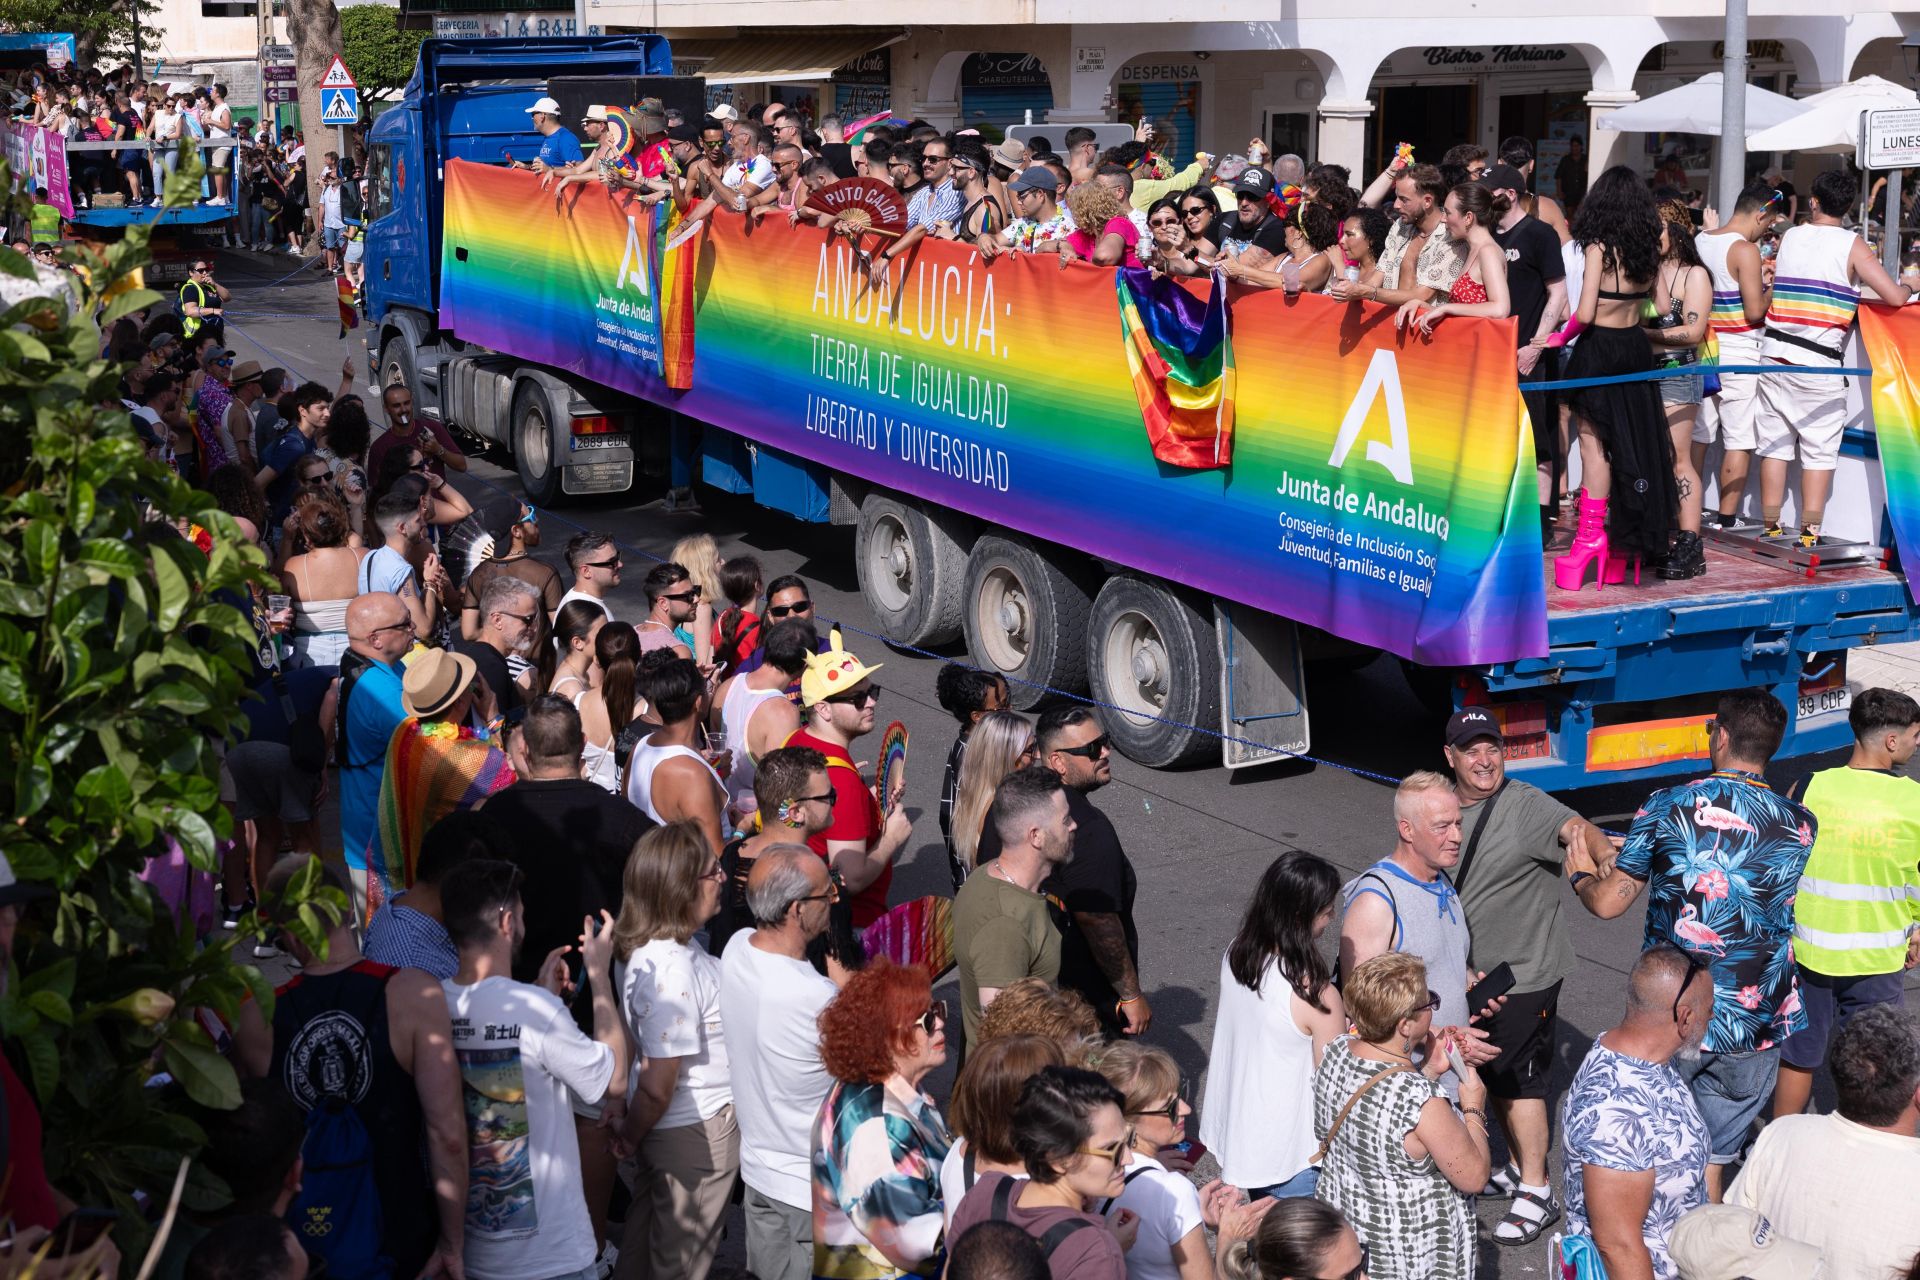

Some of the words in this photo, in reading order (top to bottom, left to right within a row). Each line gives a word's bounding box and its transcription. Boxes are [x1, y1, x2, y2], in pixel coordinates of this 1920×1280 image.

[537, 18, 600, 37] BAHA
[1423, 47, 1484, 65] Bistro
[1492, 45, 1567, 63] Adriano
[1122, 65, 1200, 80] DESPENSA
[1883, 135, 1920, 149] LUNES
[825, 186, 863, 206] PUTO
[864, 188, 900, 224] CALOR
[596, 293, 617, 313] Junta
[619, 298, 630, 316] de
[631, 301, 653, 323] Andal
[813, 242, 1011, 360] ANDALUCÍA:
[627, 328, 650, 343] Inclusión
[811, 333, 869, 391] TIERRA
[878, 351, 902, 399] DE
[911, 361, 1009, 429] IGUALDAD
[577, 437, 603, 448] 2089
[608, 435, 628, 447] CDP
[806, 393, 877, 450] LIBERTAD
[884, 417, 894, 456] Y
[901, 422, 1009, 492] DIVERSIDAD
[1276, 470, 1330, 507] Junta
[1333, 483, 1359, 514] de
[1279, 511, 1335, 540] Consejería
[1336, 527, 1353, 547] de
[1356, 532, 1413, 563] Inclusión
[1278, 535, 1333, 568] Juventud,
[1334, 551, 1387, 581] Familias
[1388, 570, 1397, 584] e
[1799, 696, 1815, 716] 89
[1820, 689, 1846, 711] CDP
[1462, 713, 1488, 724] FILA
[1536, 737, 1546, 757] R
[1835, 823, 1900, 850] PRIDE
[452, 1028, 476, 1037] ASTERS
[484, 1023, 522, 1041] 富士山
